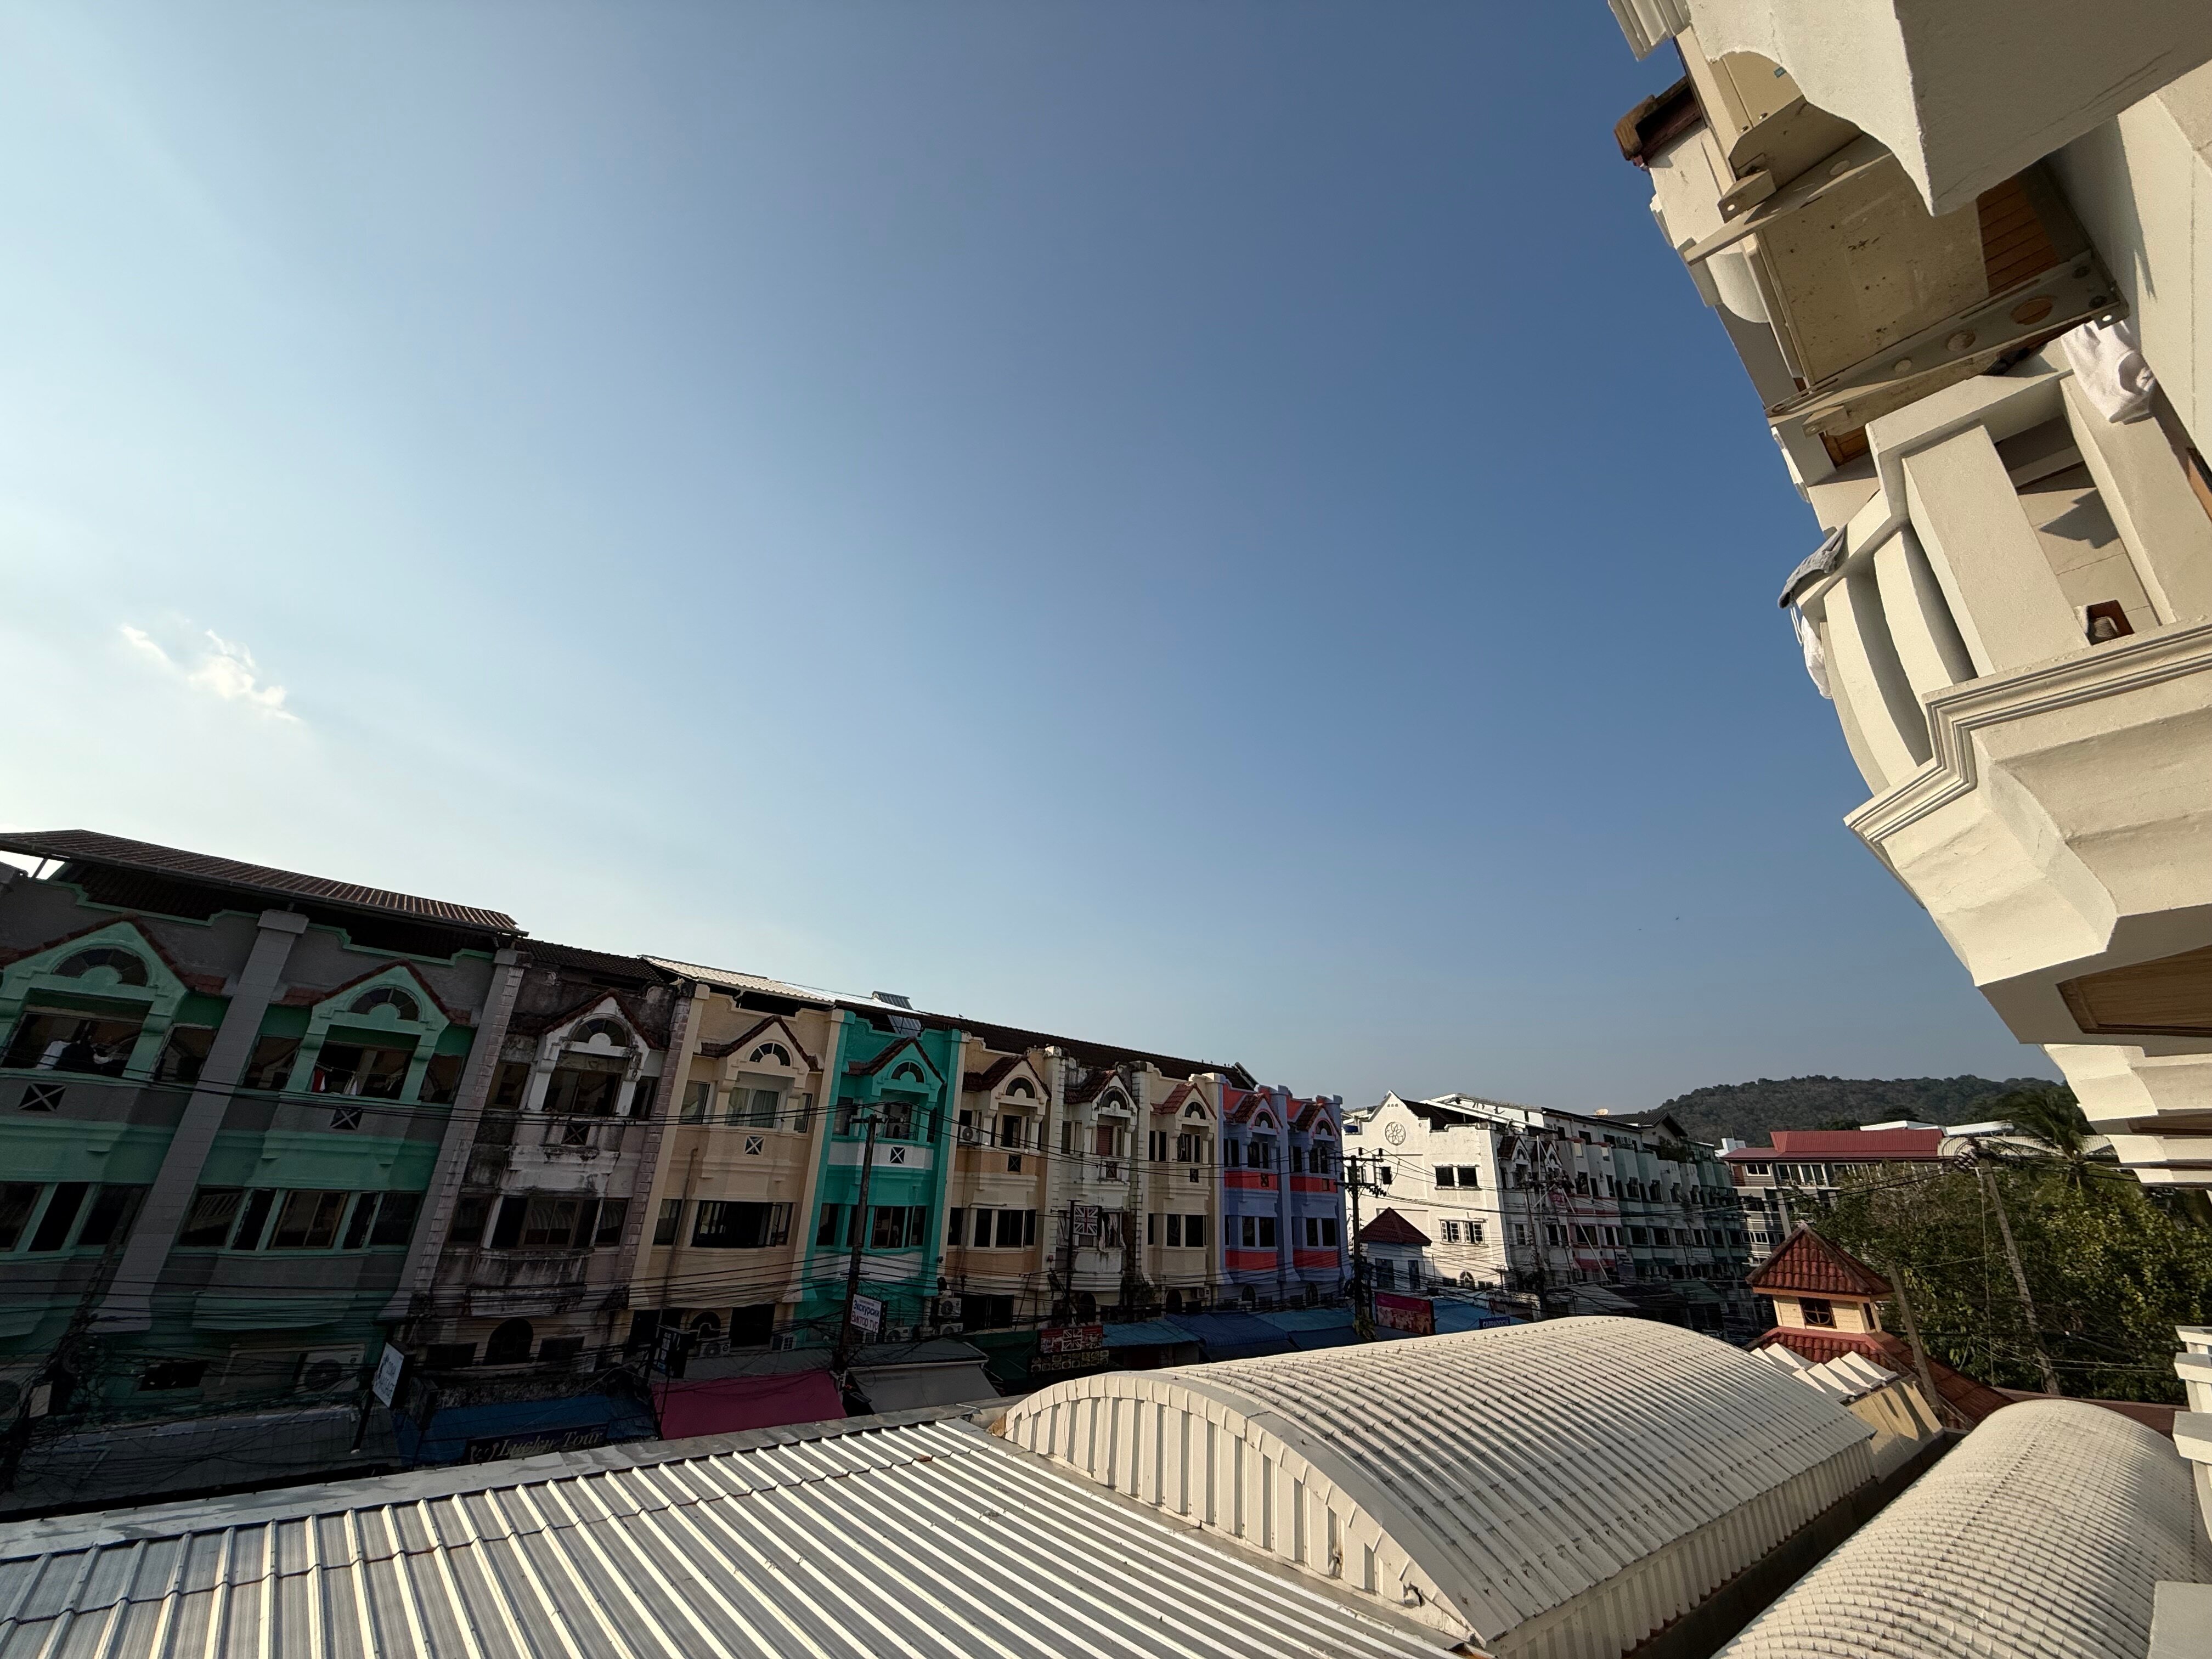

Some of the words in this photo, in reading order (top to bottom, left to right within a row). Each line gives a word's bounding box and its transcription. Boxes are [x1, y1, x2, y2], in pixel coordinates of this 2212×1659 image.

[854, 1300, 879, 1317] Экскурсии
[851, 1311, 868, 1328] Виктор
[1482, 1319, 1509, 1328] CAPPADOCIA
[496, 1435, 554, 1457] Lucky
[562, 1431, 603, 1447] Tour
